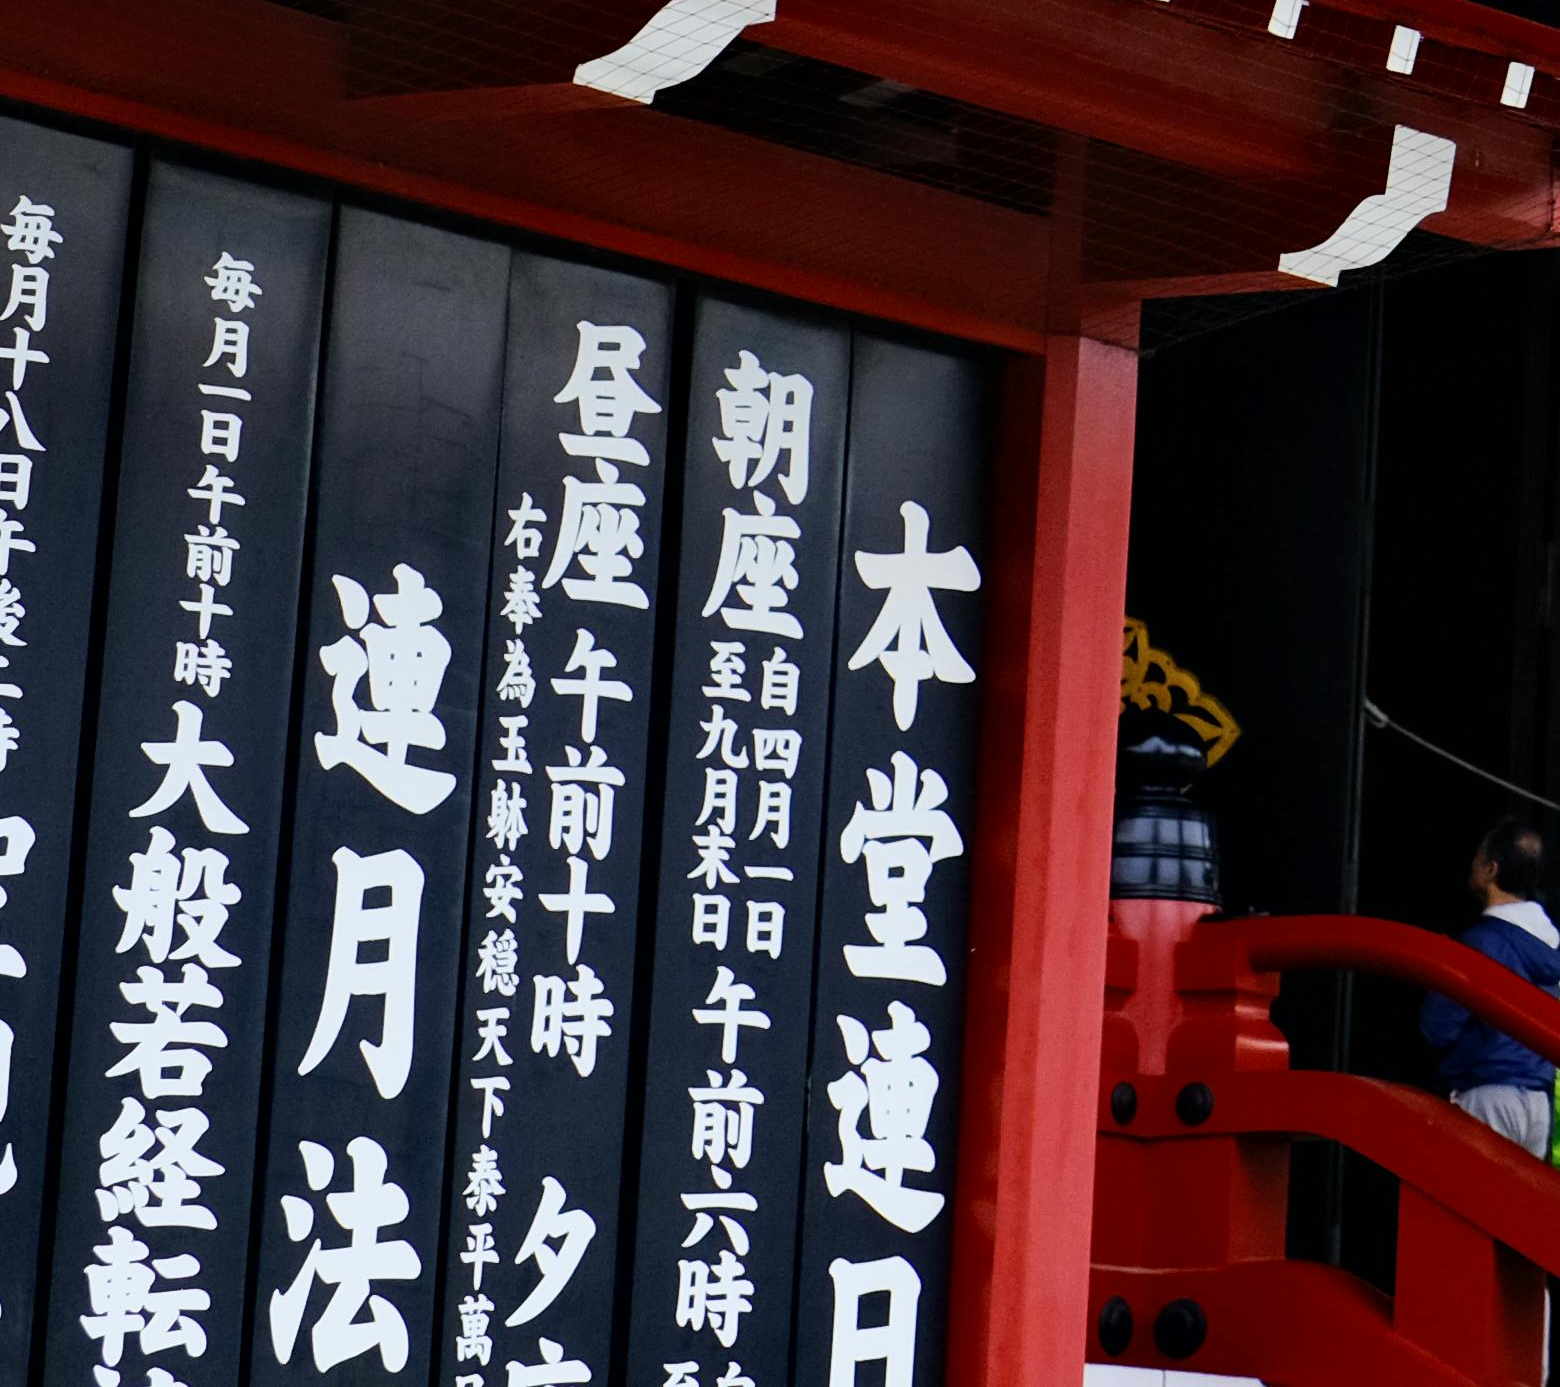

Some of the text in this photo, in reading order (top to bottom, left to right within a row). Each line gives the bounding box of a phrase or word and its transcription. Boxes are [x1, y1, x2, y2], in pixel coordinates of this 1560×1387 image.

[173, 251, 263, 698] 毎月一日午前十時
[701, 349, 814, 640] 朝座
[455, 491, 548, 1387] 右奉為玉躰安穏天下泰平萬
[530, 627, 634, 1078] 午前十時
[686, 640, 752, 951] 至九月末日
[743, 646, 803, 960] 自四月一日
[80, 700, 250, 1387] 大般若経転
[675, 965, 771, 1348] 午前六時
